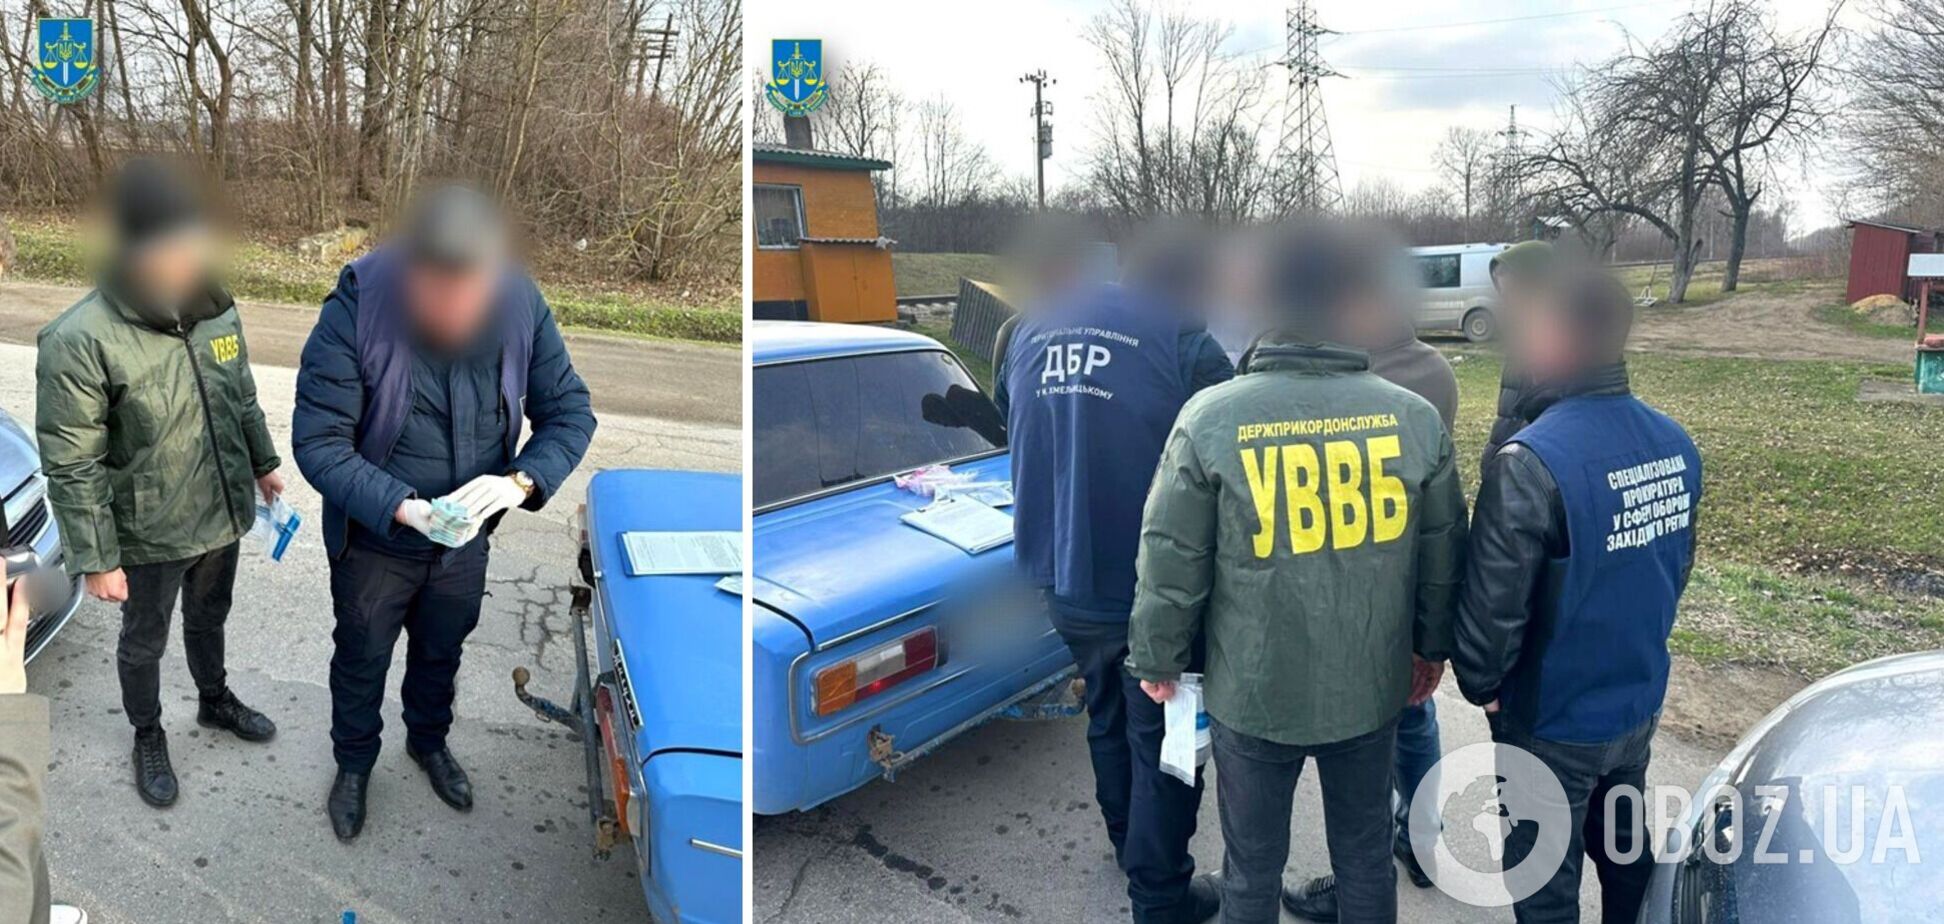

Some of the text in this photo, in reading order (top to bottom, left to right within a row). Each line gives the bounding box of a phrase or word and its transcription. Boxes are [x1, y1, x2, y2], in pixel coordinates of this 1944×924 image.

[210, 334, 239, 365] УВВБ
[1083, 327, 1139, 348] УПРАВЛІННЯ
[1042, 342, 1111, 384] ДБР
[1237, 413, 1398, 443] ДЕРЖПРИКОРДОНСЛУЖБА
[1240, 435, 1408, 559] УВВБ
[1622, 476, 1685, 509] ПРОКУРАТУРА
[1613, 513, 1621, 532] У
[1623, 503, 1652, 529] СФЕРІ
